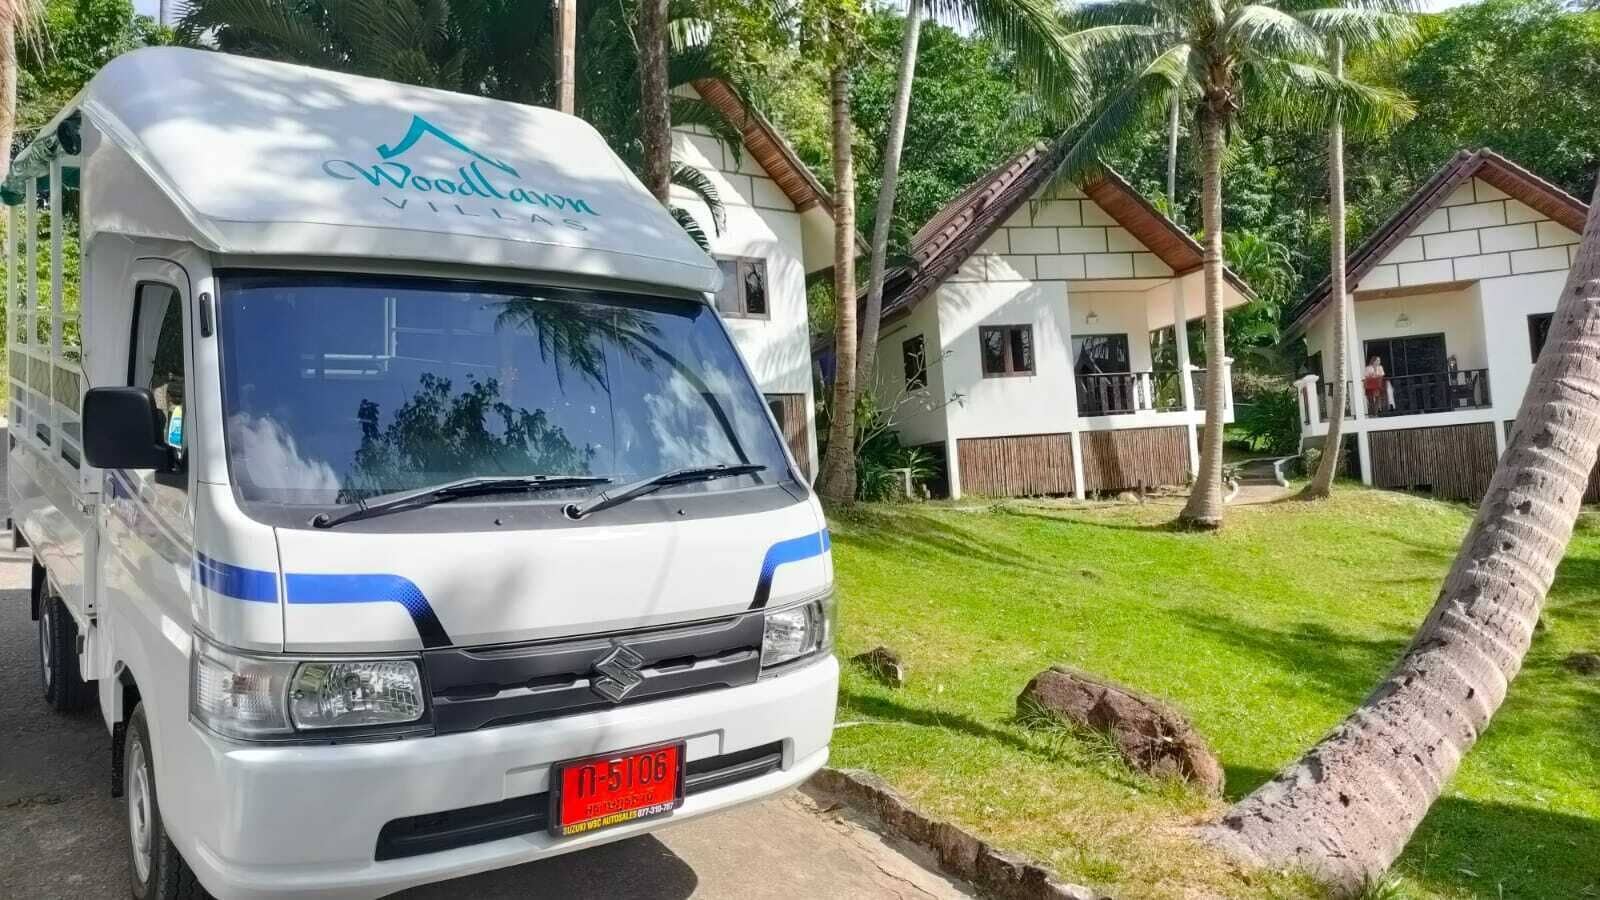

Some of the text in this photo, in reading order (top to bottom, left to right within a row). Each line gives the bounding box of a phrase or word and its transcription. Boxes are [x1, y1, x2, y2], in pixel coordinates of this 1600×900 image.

[322, 159, 600, 216] Woodlawn
[382, 196, 588, 232] VILLAS
[563, 823, 586, 836] SUZUKI
[602, 810, 637, 826] AUTOSALES
